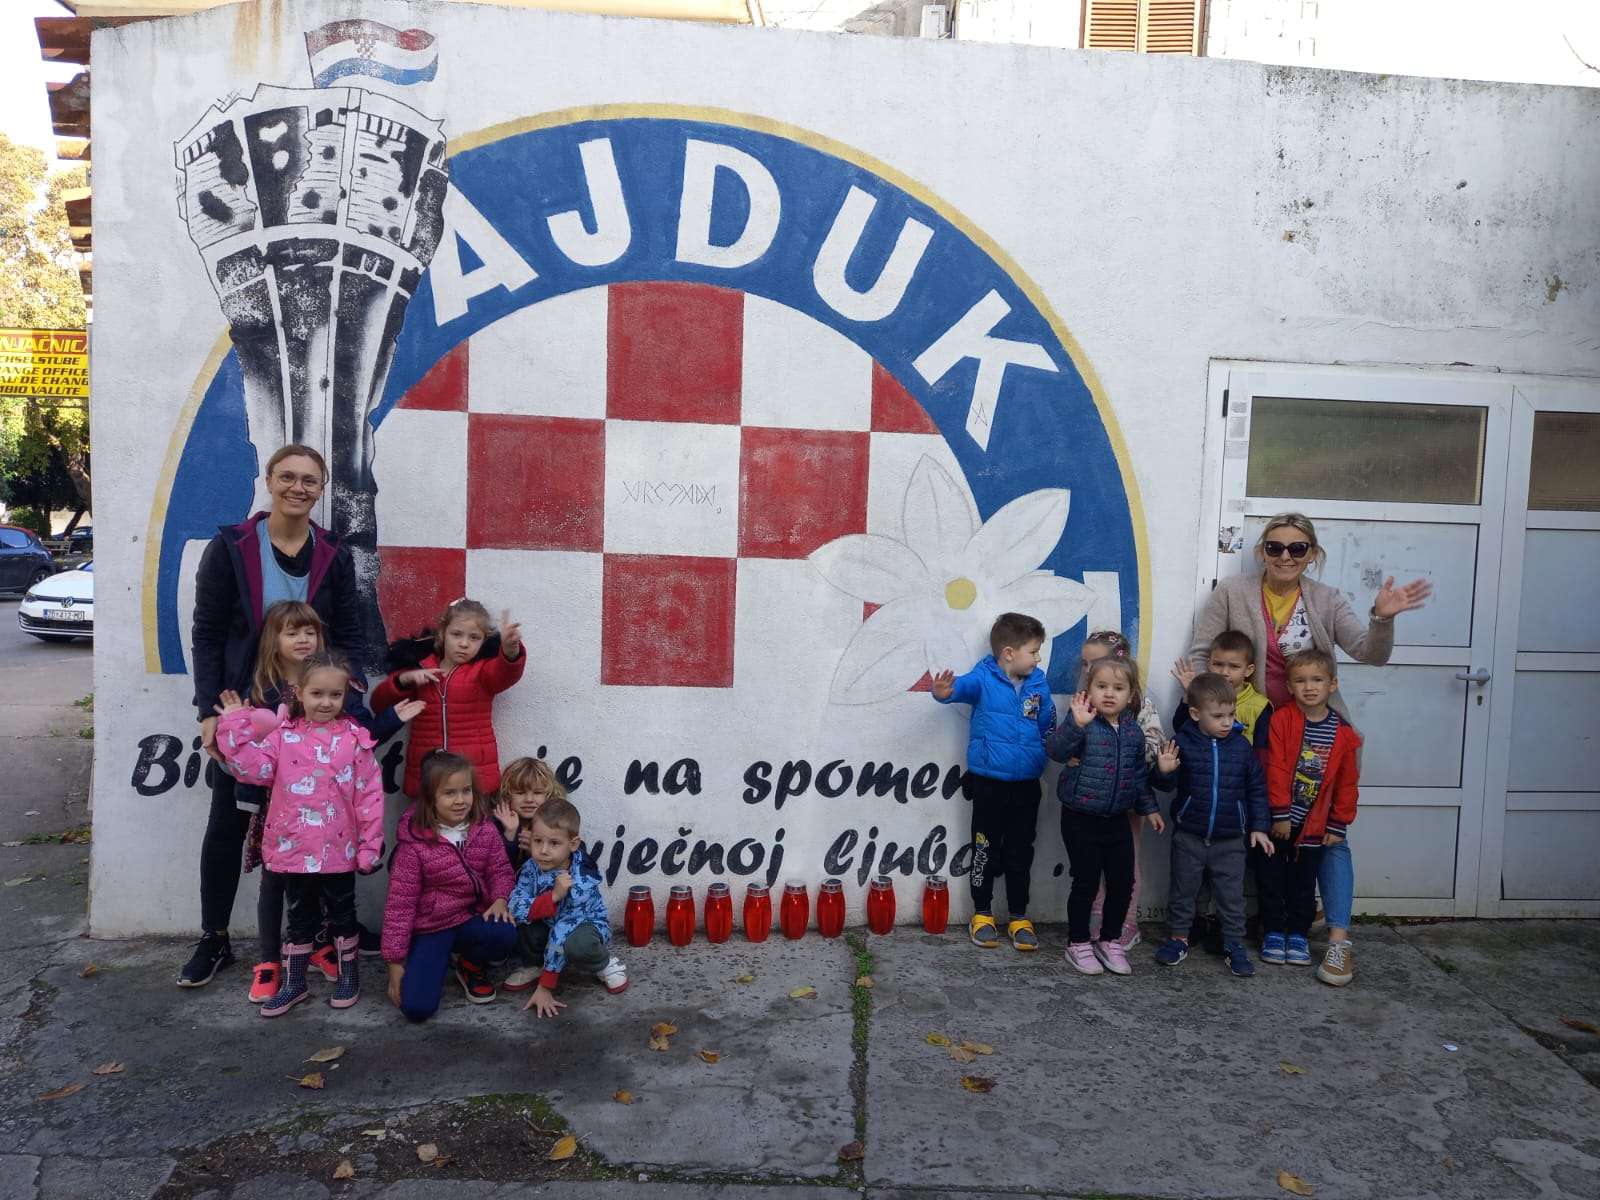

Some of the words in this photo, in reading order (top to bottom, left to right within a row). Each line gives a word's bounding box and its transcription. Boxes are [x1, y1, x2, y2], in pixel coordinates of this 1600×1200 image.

[42, 367, 88, 376] OFFICE
[20, 376, 40, 384] DE
[31, 387, 81, 396] VALUTE
[624, 757, 701, 796] na
